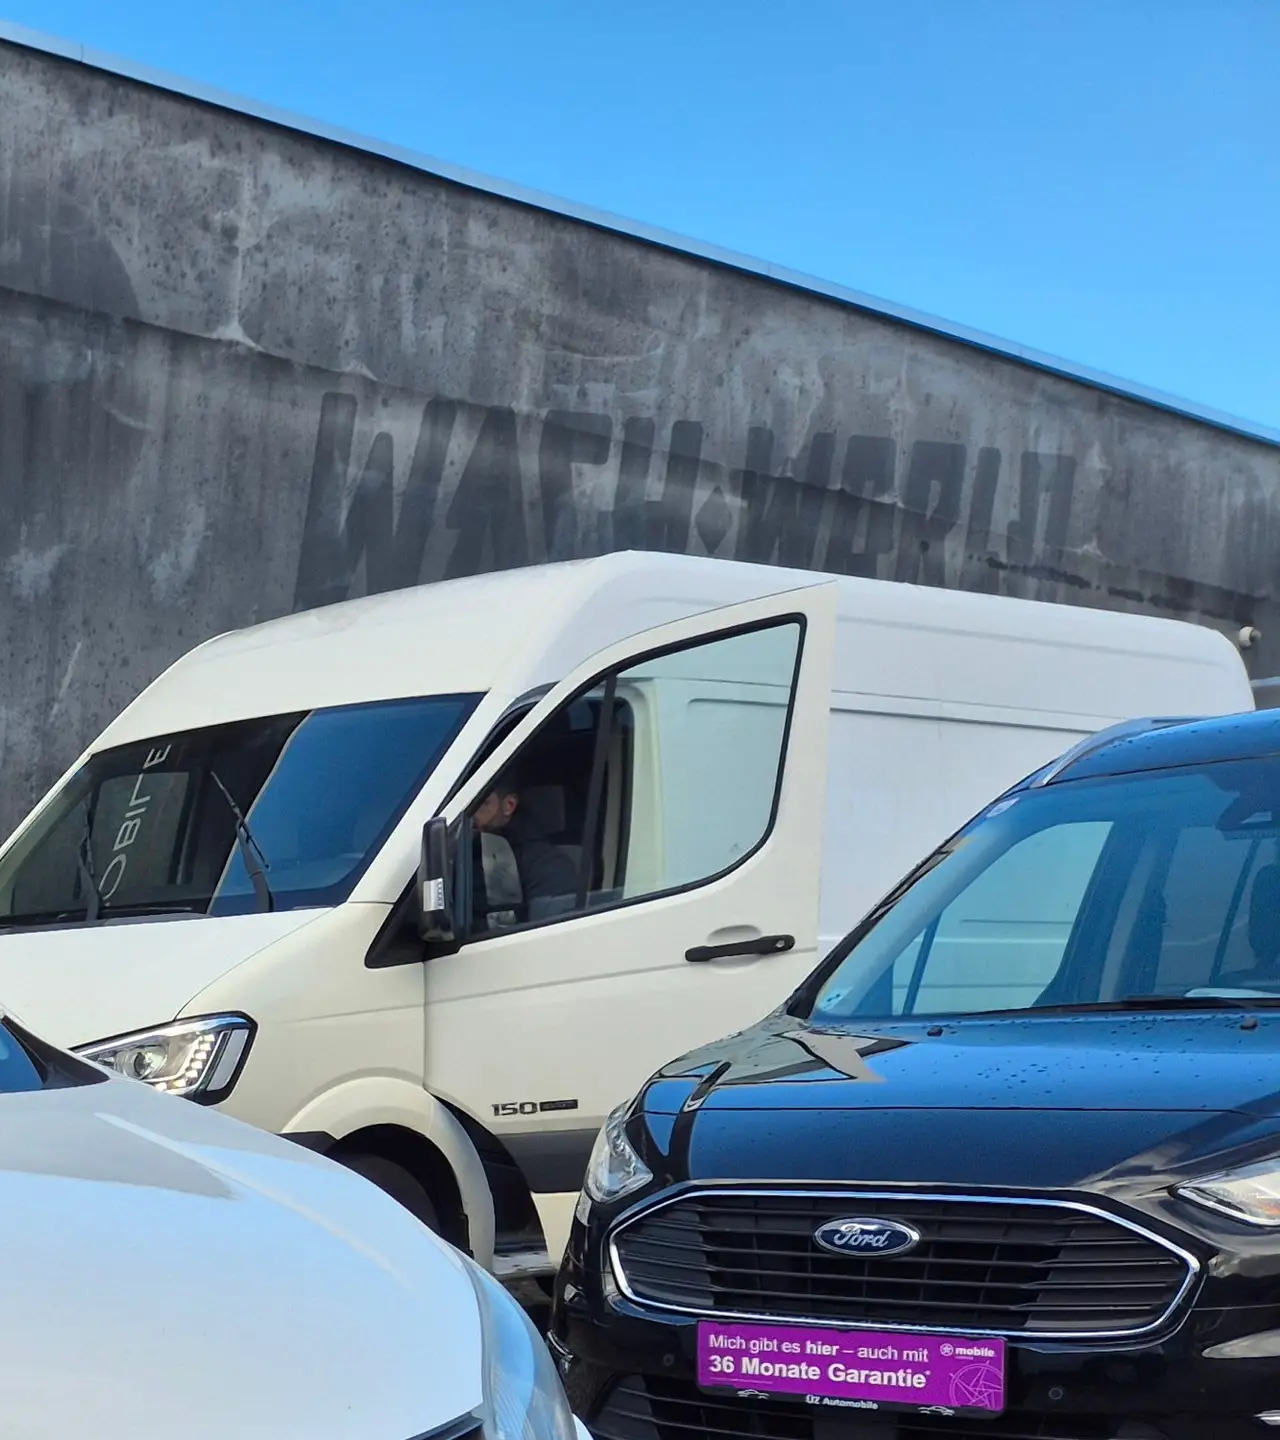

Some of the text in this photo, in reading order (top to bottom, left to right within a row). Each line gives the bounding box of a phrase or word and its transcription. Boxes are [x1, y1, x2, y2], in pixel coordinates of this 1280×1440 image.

[491, 1102, 538, 1117] 150
[833, 1223, 892, 1248] Ford
[709, 1334, 746, 1350] Mich
[749, 1337, 778, 1354] gibt
[781, 1341, 801, 1354] es
[805, 1341, 840, 1356] hier
[857, 1345, 898, 1361] auch
[902, 1348, 929, 1363] mit
[708, 1354, 735, 1373] 36
[741, 1356, 821, 1380] Monate
[822, 1397, 879, 1410] Automobile
